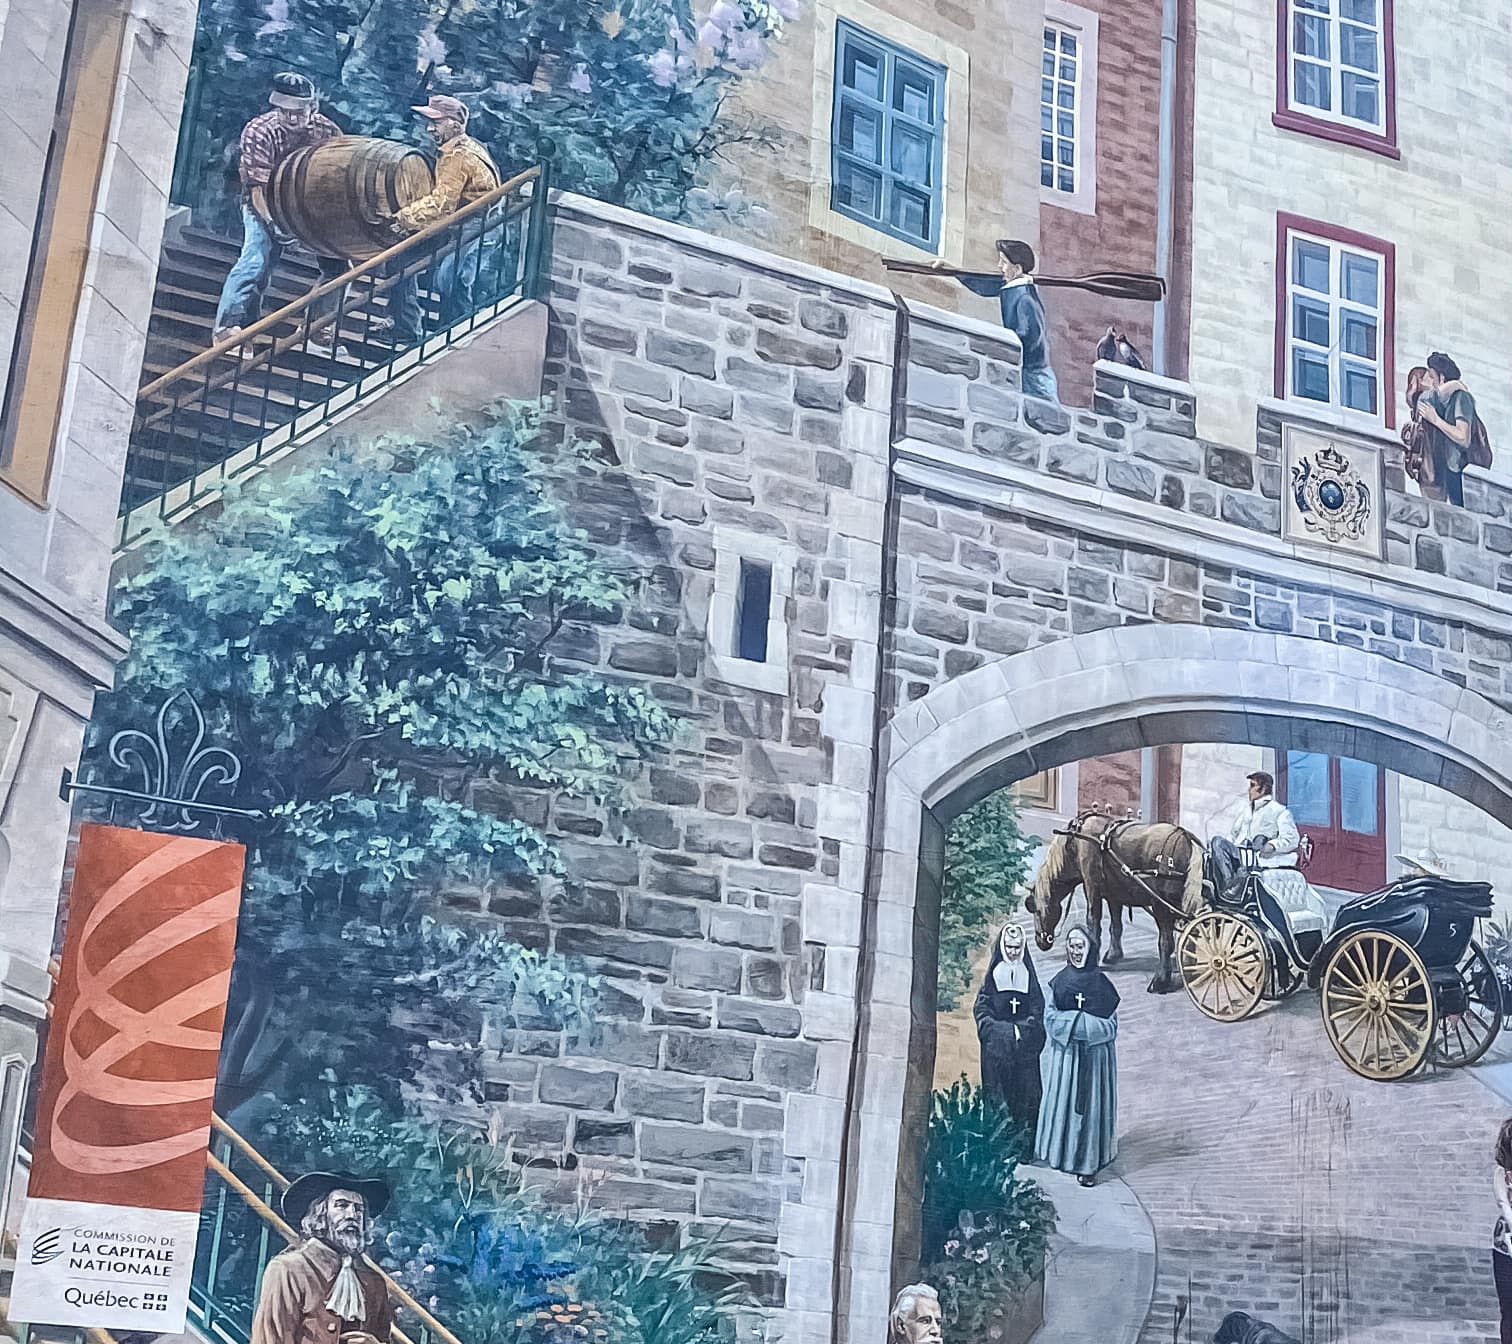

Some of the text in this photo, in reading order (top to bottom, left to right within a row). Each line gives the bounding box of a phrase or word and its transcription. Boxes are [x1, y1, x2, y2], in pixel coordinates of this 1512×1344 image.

[1449, 922, 1457, 937] 5
[74, 1228, 176, 1247] COMMISSION DE
[72, 1241, 174, 1262] LA CAPITALE
[69, 1258, 173, 1277] NATIONALE
[64, 1287, 140, 1309] Québec
